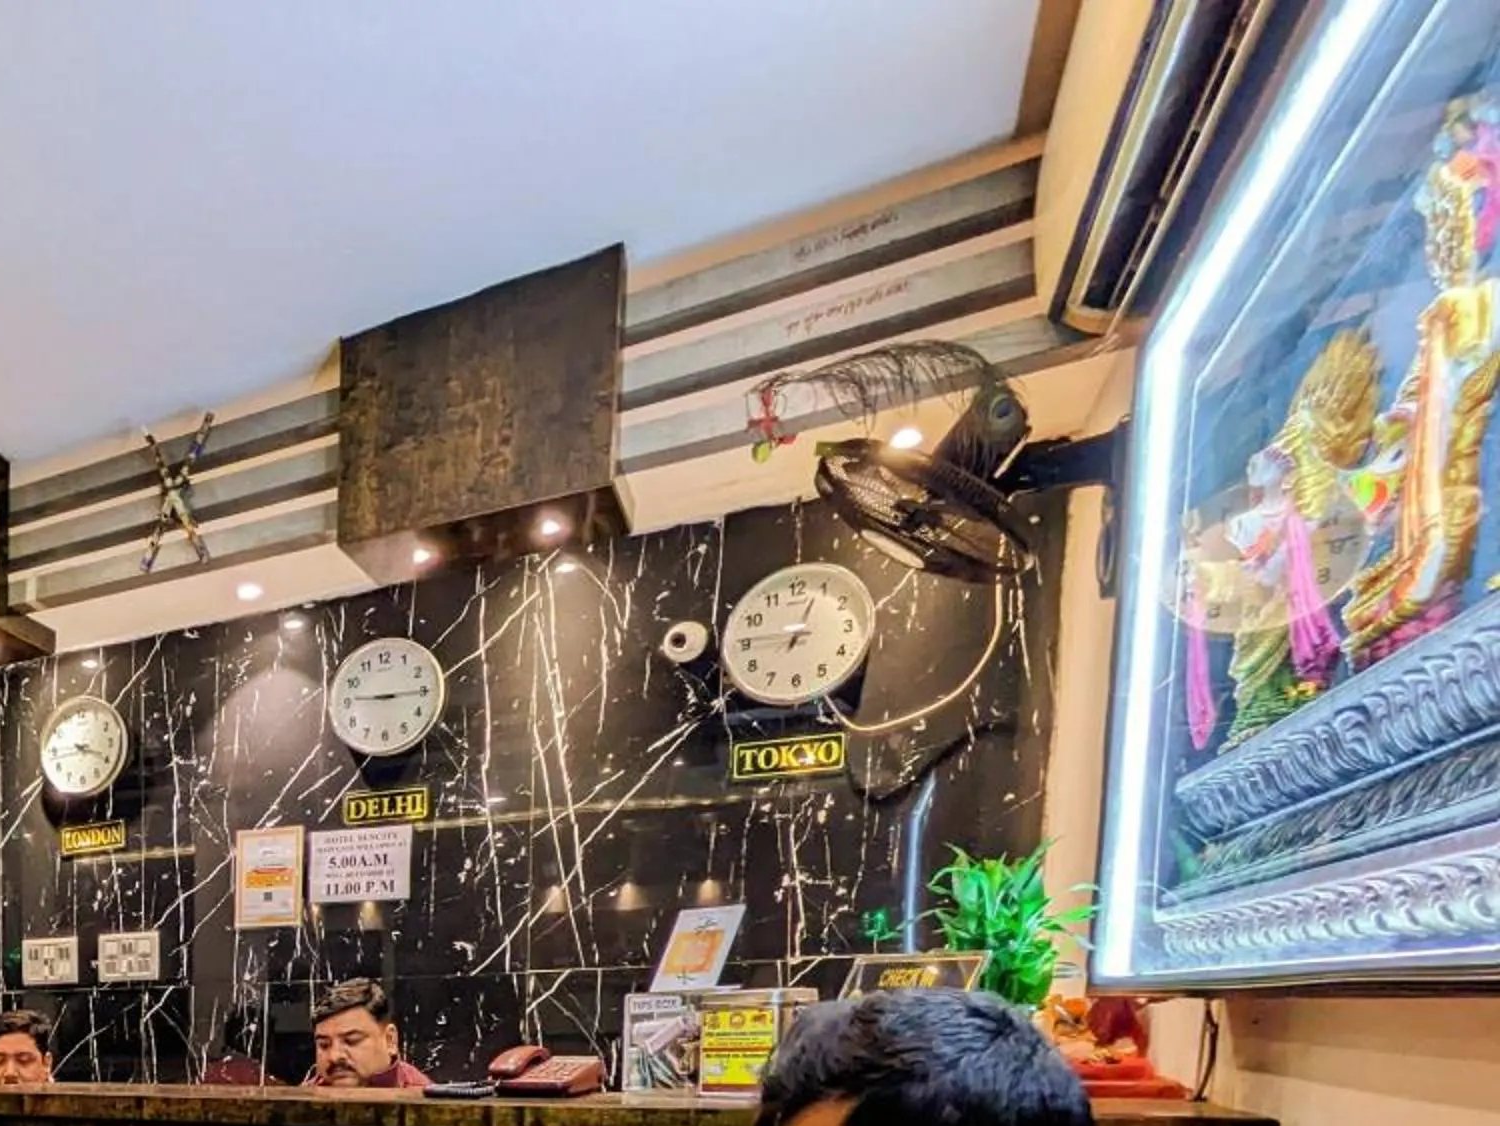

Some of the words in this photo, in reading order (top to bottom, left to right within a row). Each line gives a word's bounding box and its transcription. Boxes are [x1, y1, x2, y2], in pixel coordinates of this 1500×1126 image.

[788, 580, 806, 595] 12
[819, 582, 827, 595] 1
[764, 594, 779, 607] 11
[837, 596, 847, 611] 2
[746, 613, 763, 627] 10
[843, 620, 853, 633] 3
[740, 638, 751, 651] 9
[836, 644, 846, 656] 4
[378, 651, 391, 664] 12
[401, 654, 407, 665] 1
[361, 661, 371, 672] 11
[414, 666, 422, 678] 2
[747, 660, 757, 673] 8
[818, 664, 828, 678] 5
[347, 677, 360, 688] 10
[766, 671, 777, 686] 7
[791, 674, 801, 687] 6
[344, 698, 351, 709] 9
[415, 706, 422, 717] 4
[349, 716, 357, 728] 8
[400, 722, 408, 733] 5
[363, 728, 371, 739] 7
[381, 730, 389, 741] 6
[739, 740, 840, 772] TOKYO
[349, 794, 423, 819] DELHI
[65, 825, 121, 849] LONDON
[325, 881, 361, 897] 11.00
[365, 879, 395, 893] P.M
[878, 967, 921, 988] CHECK
